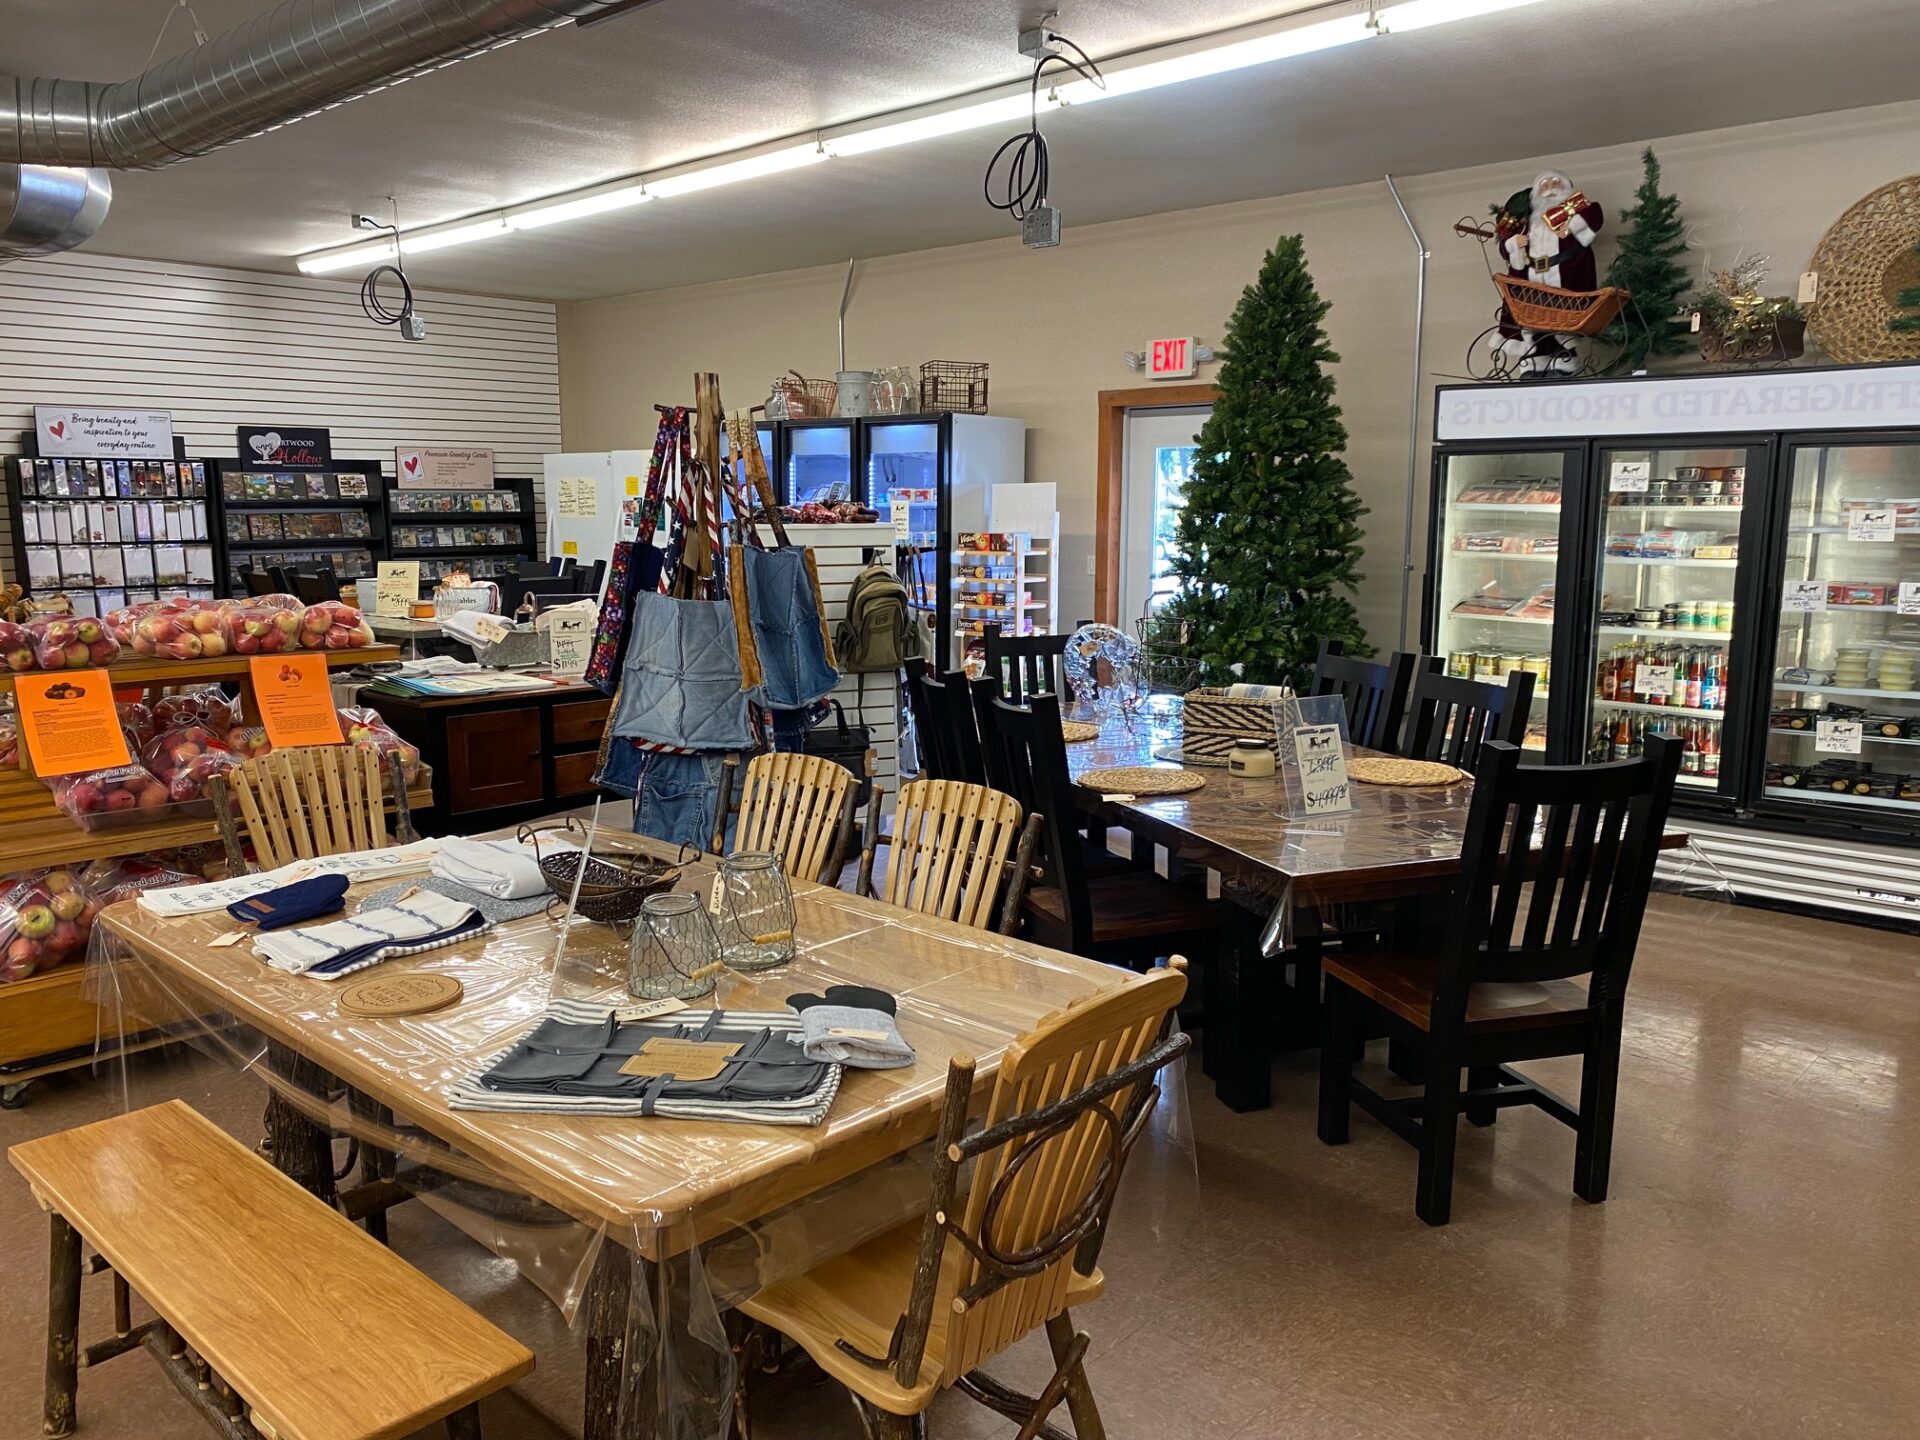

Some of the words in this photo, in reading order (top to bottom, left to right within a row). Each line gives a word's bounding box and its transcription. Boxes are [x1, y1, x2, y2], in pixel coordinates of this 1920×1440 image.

[1152, 339, 1187, 372] EXIT
[71, 412, 96, 428] Bring
[96, 415, 122, 428] beauty
[122, 416, 138, 425] and
[83, 427, 123, 439] inspiration
[124, 428, 132, 436] to
[132, 430, 148, 440] your
[96, 441, 130, 451] everyday
[130, 441, 157, 449] routine
[271, 446, 322, 464] Hollow
[424, 450, 448, 458] Premium
[448, 451, 471, 461] Greeting
[471, 451, 488, 459] Cards
[959, 593, 977, 602] Breton
